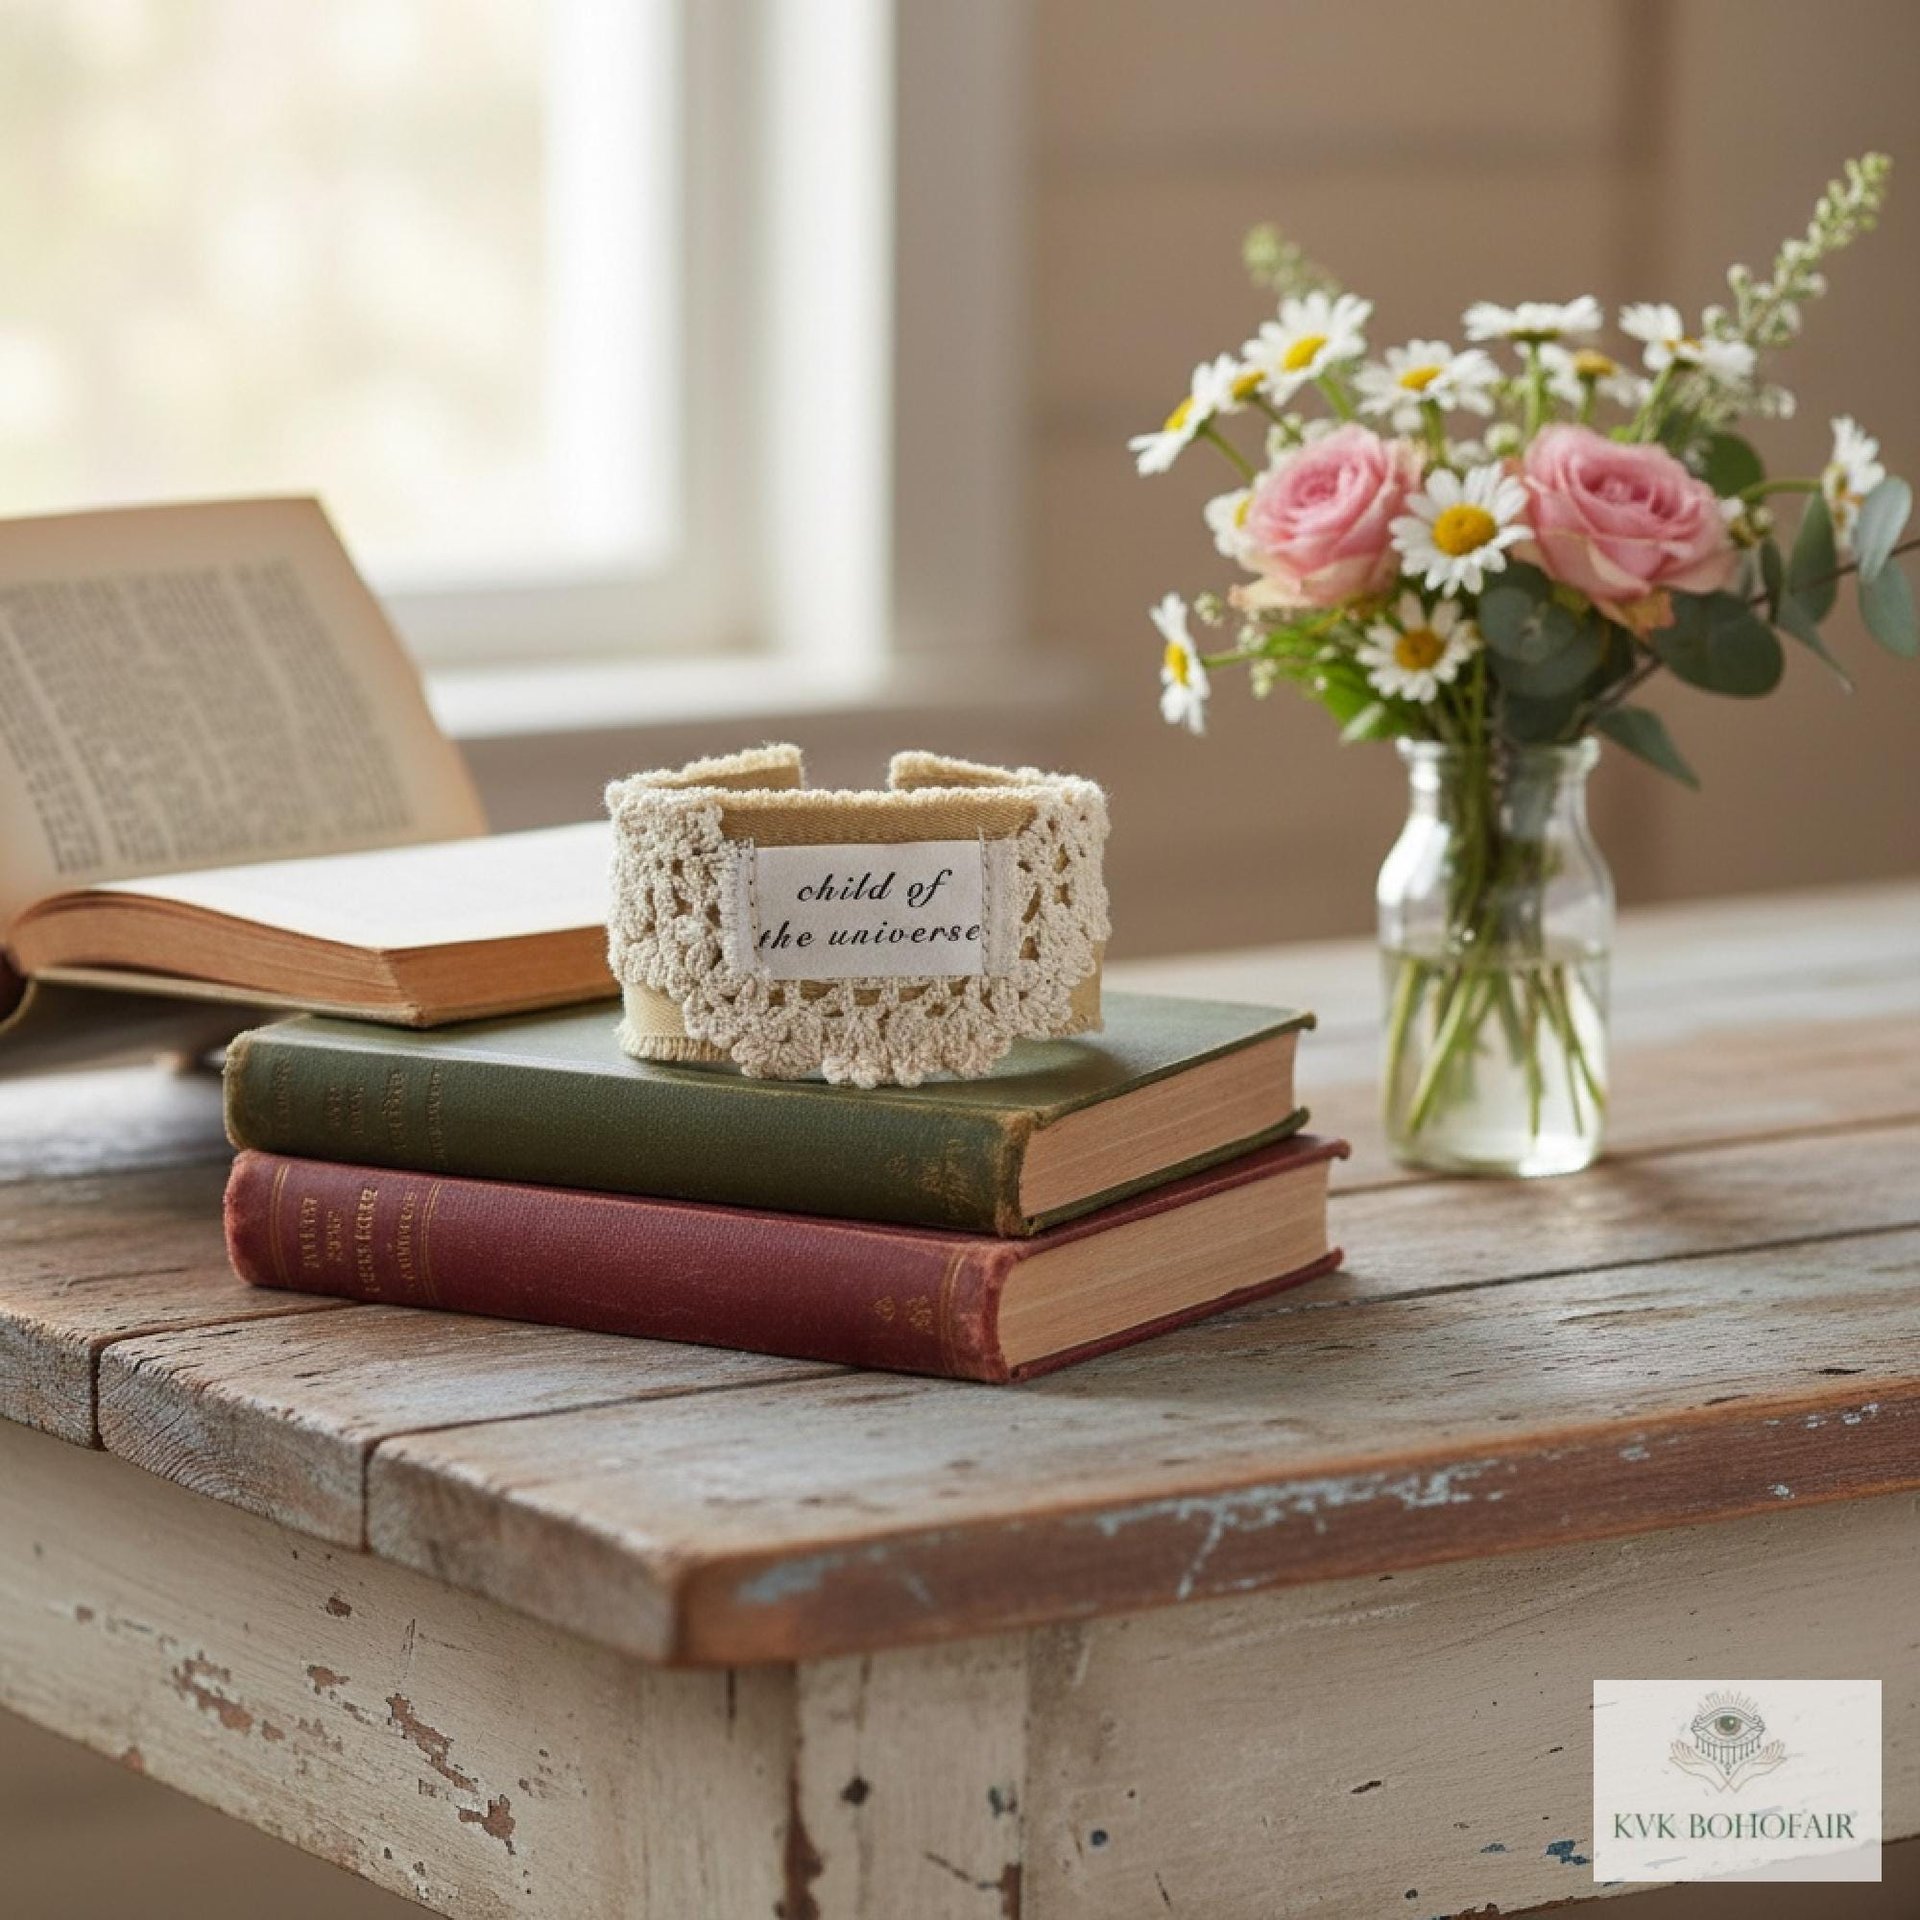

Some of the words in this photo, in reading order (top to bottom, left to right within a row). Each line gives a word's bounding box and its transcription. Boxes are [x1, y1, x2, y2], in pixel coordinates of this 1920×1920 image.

[797, 871, 895, 902] child
[906, 868, 953, 908] of
[758, 920, 814, 950] the
[828, 920, 981, 946] universe
